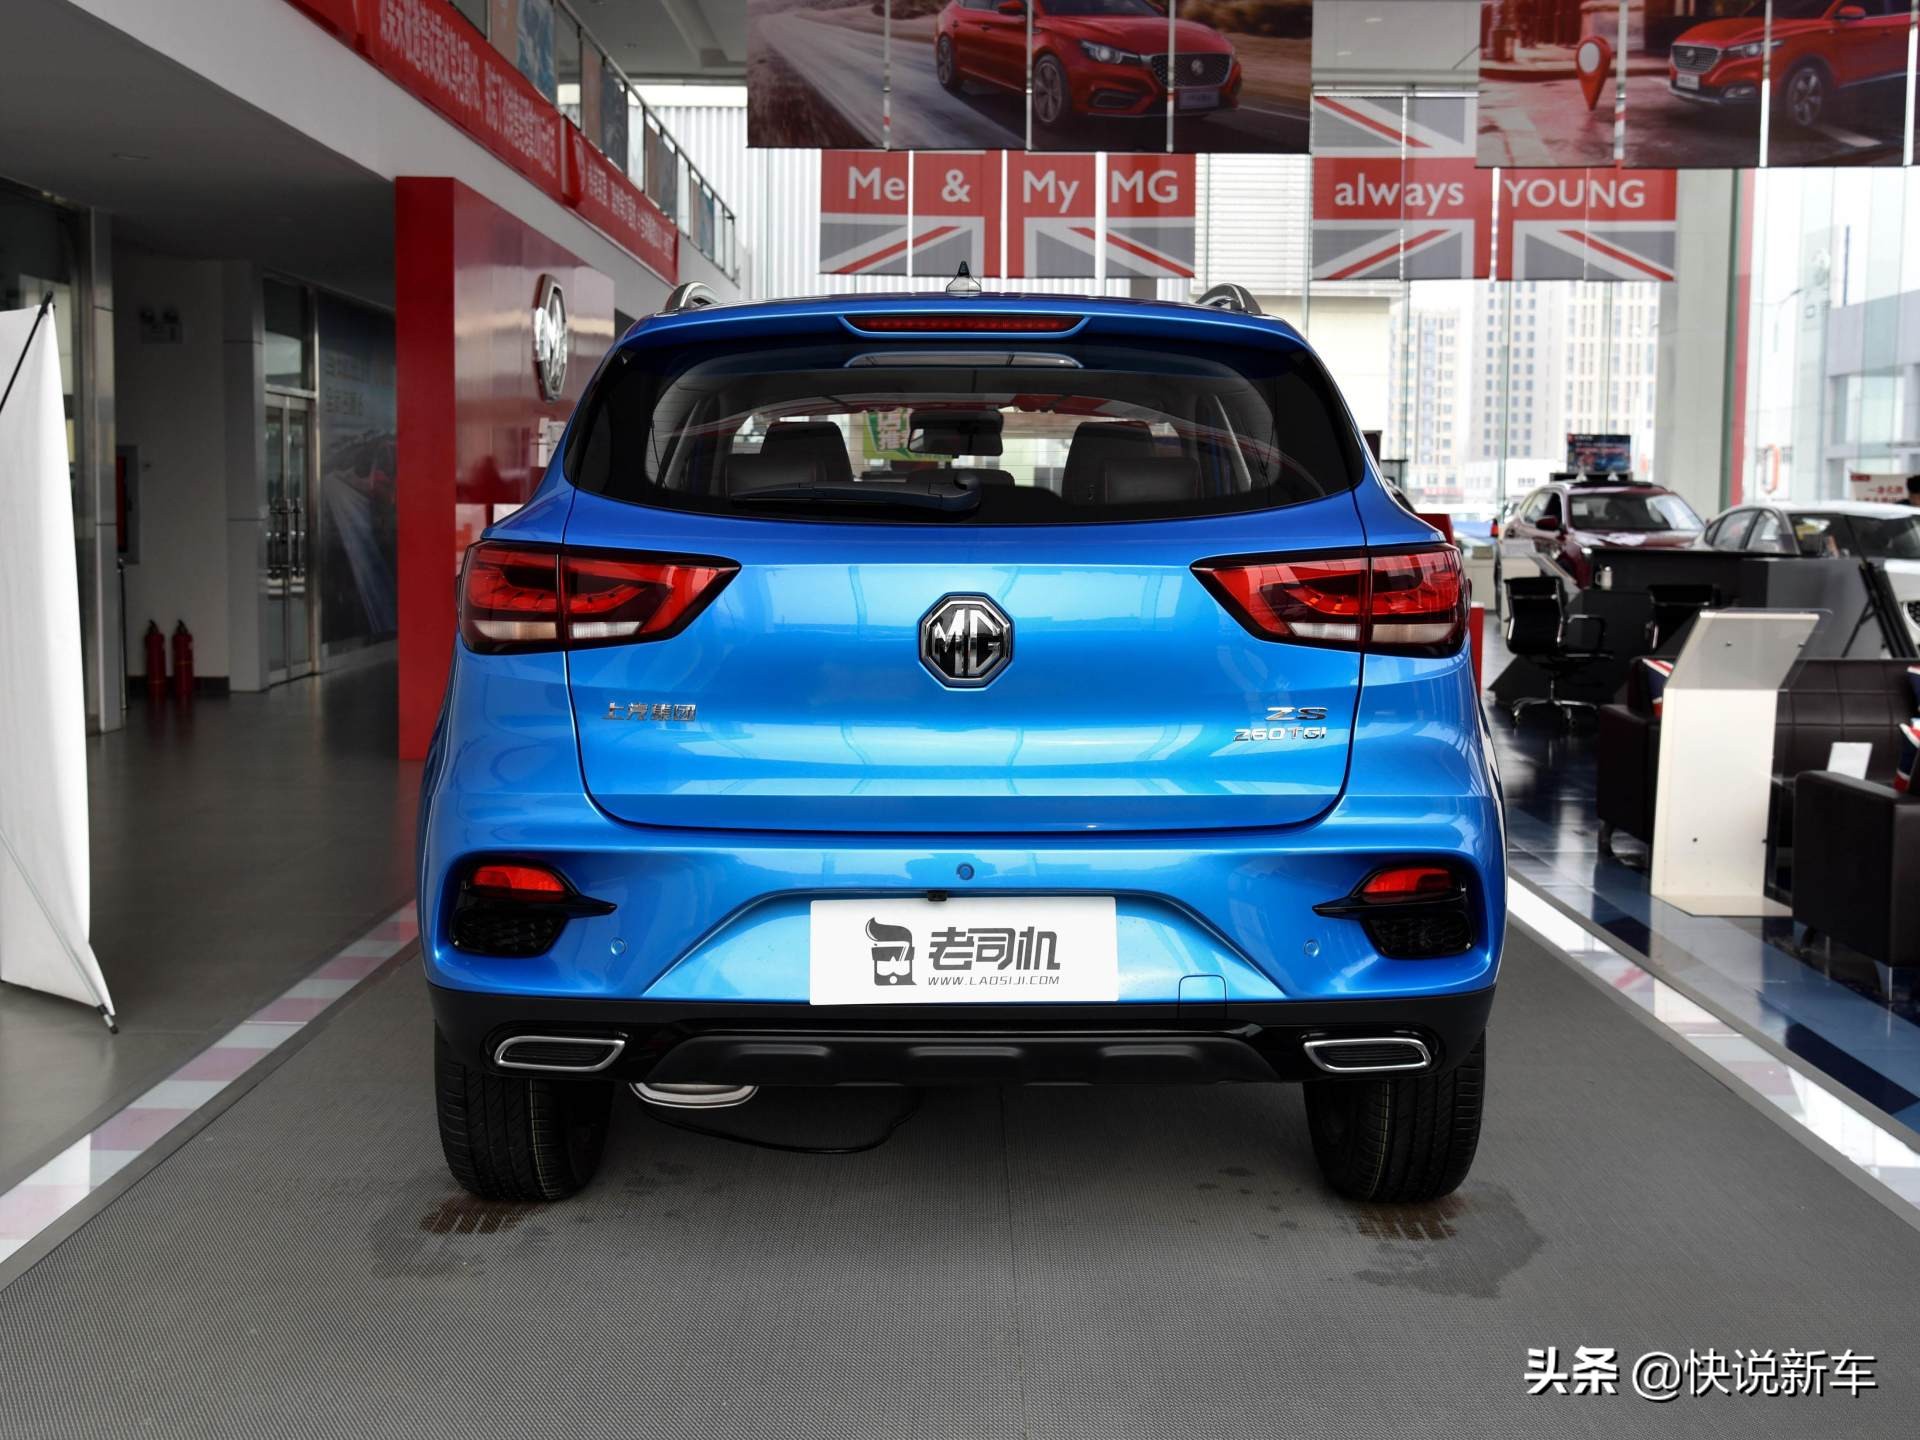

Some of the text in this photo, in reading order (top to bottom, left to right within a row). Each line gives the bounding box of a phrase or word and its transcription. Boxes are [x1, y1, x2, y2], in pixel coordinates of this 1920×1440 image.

[848, 166, 1179, 214] Me & My MG
[1334, 173, 1646, 216] always YOUNG
[928, 605, 1004, 679] MG
[602, 702, 697, 721] 上汽集团
[1265, 706, 1329, 721] ZS
[1233, 726, 1328, 742] 260TGI
[928, 926, 1061, 971] 老司机
[928, 974, 1060, 986] WWW.LAOSIJI.COM
